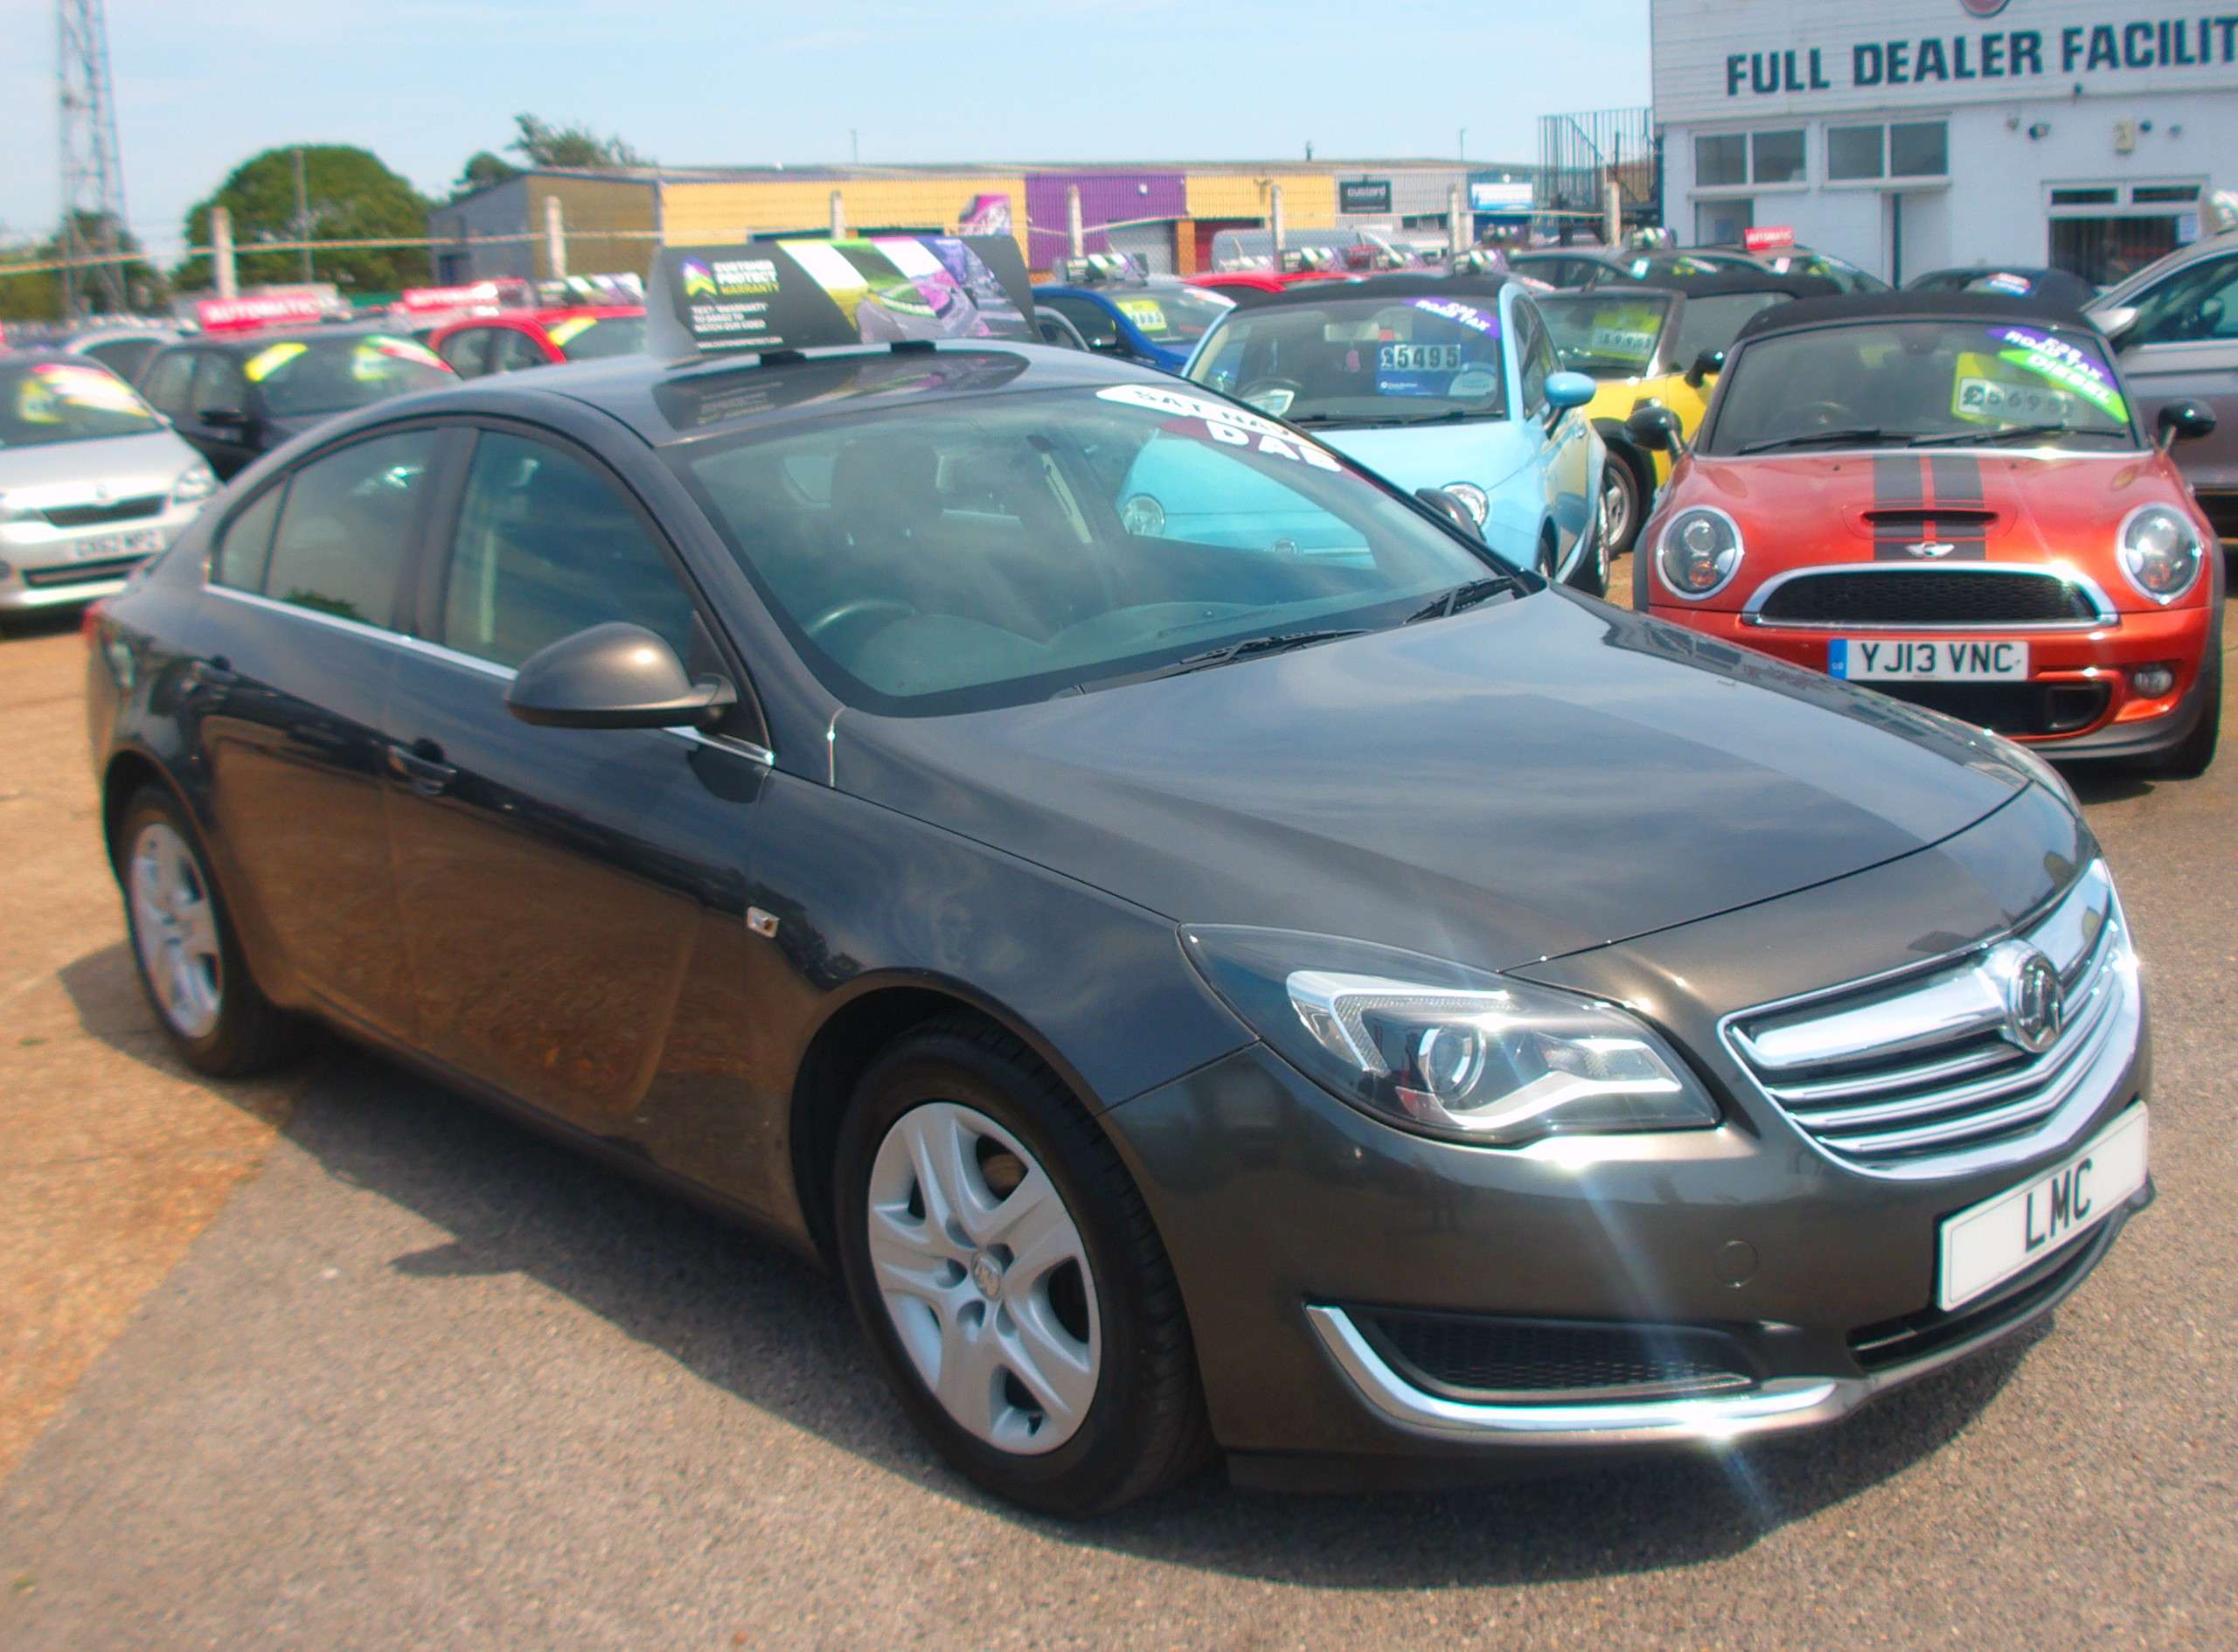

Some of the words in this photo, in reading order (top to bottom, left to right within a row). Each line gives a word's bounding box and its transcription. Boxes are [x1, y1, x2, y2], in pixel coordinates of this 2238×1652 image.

[1726, 47, 1831, 96] FULL
[1852, 30, 2043, 87] DEALER
[2061, 17, 2238, 73] FACILIT
[719, 282, 781, 295] WARRANTY
[2027, 354, 2111, 406] DIESEL
[1860, 642, 1937, 674] YJ13
[1949, 642, 2015, 674] VNC
[2025, 1157, 2094, 1253] LMC
